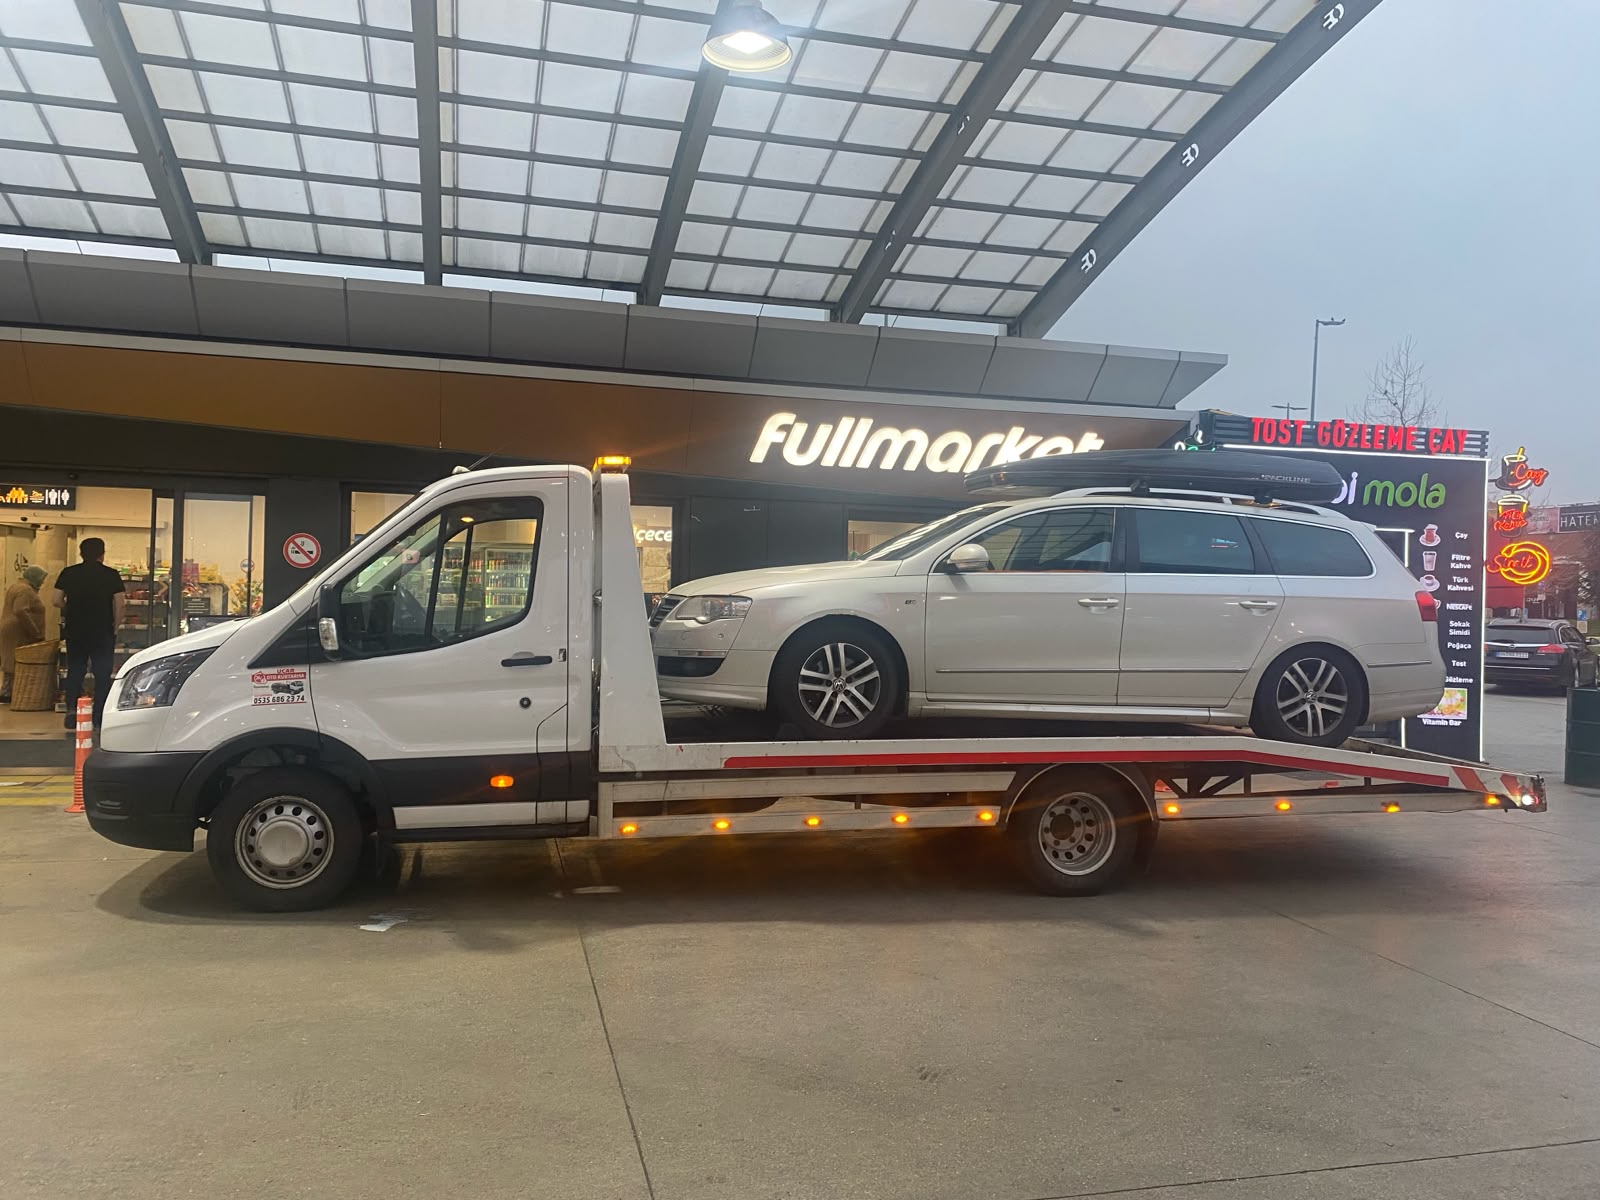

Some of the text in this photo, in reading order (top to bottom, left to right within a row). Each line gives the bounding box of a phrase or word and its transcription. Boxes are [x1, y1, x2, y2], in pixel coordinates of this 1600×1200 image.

[1252, 417, 1468, 455] TOST GÖZLEME ÇAY
[1362, 473, 1446, 509] mola
[633, 529, 672, 544] çece
[1455, 531, 1468, 540] Çay
[1449, 620, 1471, 628] Sokak
[1447, 642, 1472, 650] Poğaça
[253, 696, 271, 704] 0535
[272, 695, 285, 703] 686
[1422, 718, 1462, 727] Vitamin Bar
